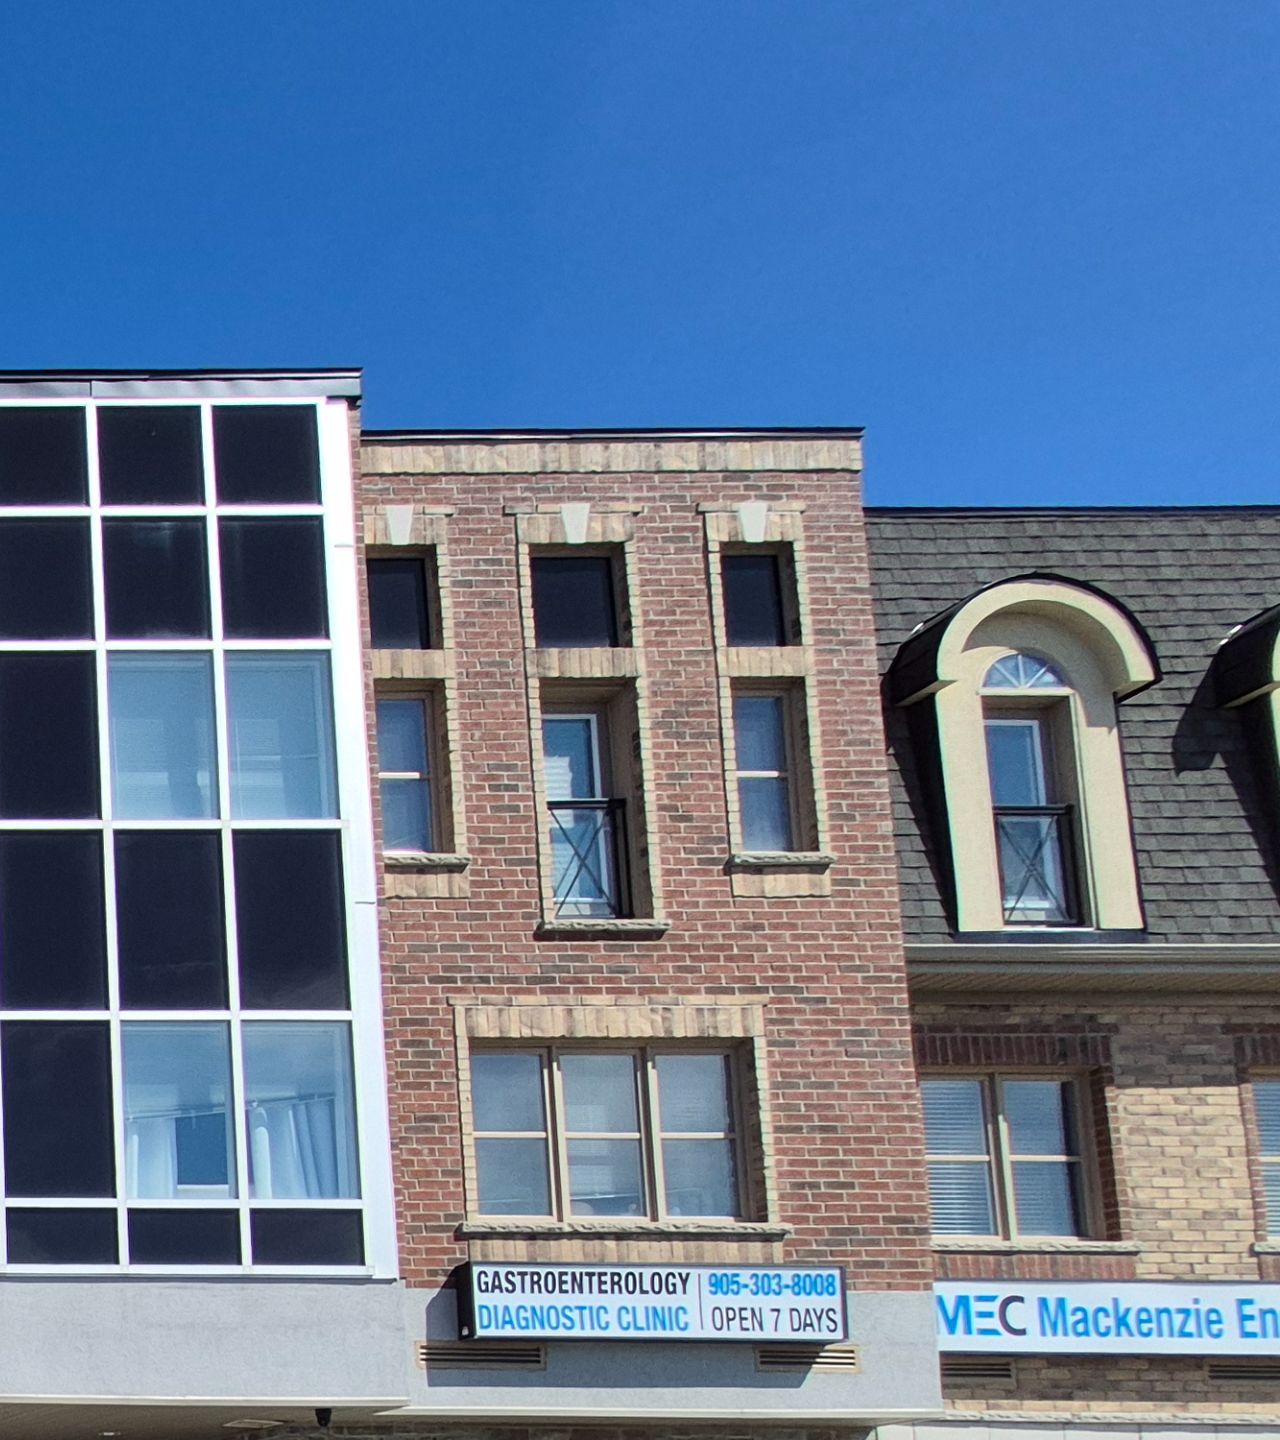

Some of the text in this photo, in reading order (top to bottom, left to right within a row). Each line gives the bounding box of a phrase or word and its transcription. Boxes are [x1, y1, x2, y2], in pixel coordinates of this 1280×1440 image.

[477, 1270, 690, 1295] GASTROENTEROLOGY
[708, 1272, 837, 1296] 905-303-8008
[478, 1304, 689, 1332] DIAGNOSTIC CLINIC
[711, 1306, 839, 1333] OPEN 7 DAYS
[936, 1294, 1027, 1337] MEC
[1038, 1297, 1224, 1339] Mackenzie
